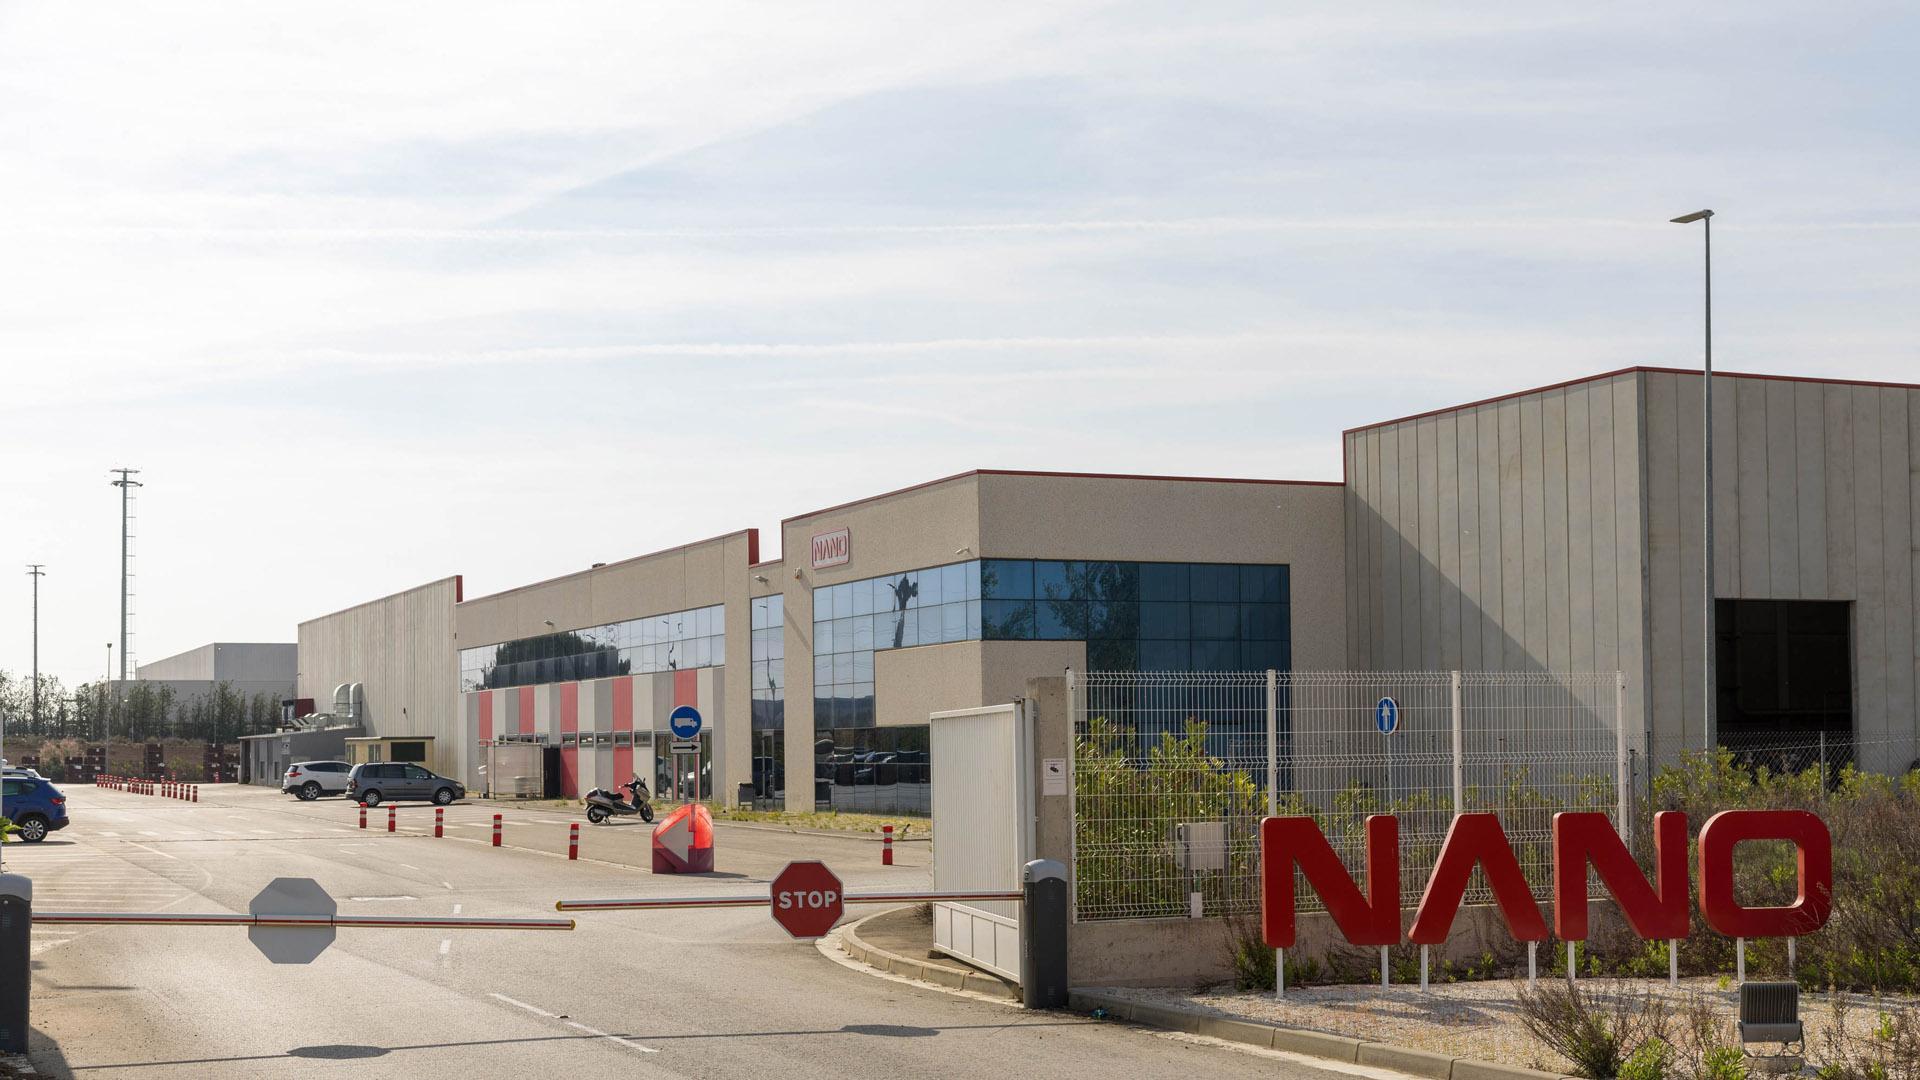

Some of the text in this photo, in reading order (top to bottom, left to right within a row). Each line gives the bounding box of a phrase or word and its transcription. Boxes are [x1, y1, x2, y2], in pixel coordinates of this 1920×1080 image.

[814, 535, 847, 561] NANO
[1261, 810, 1832, 948] NANO
[778, 890, 837, 909] STOP
